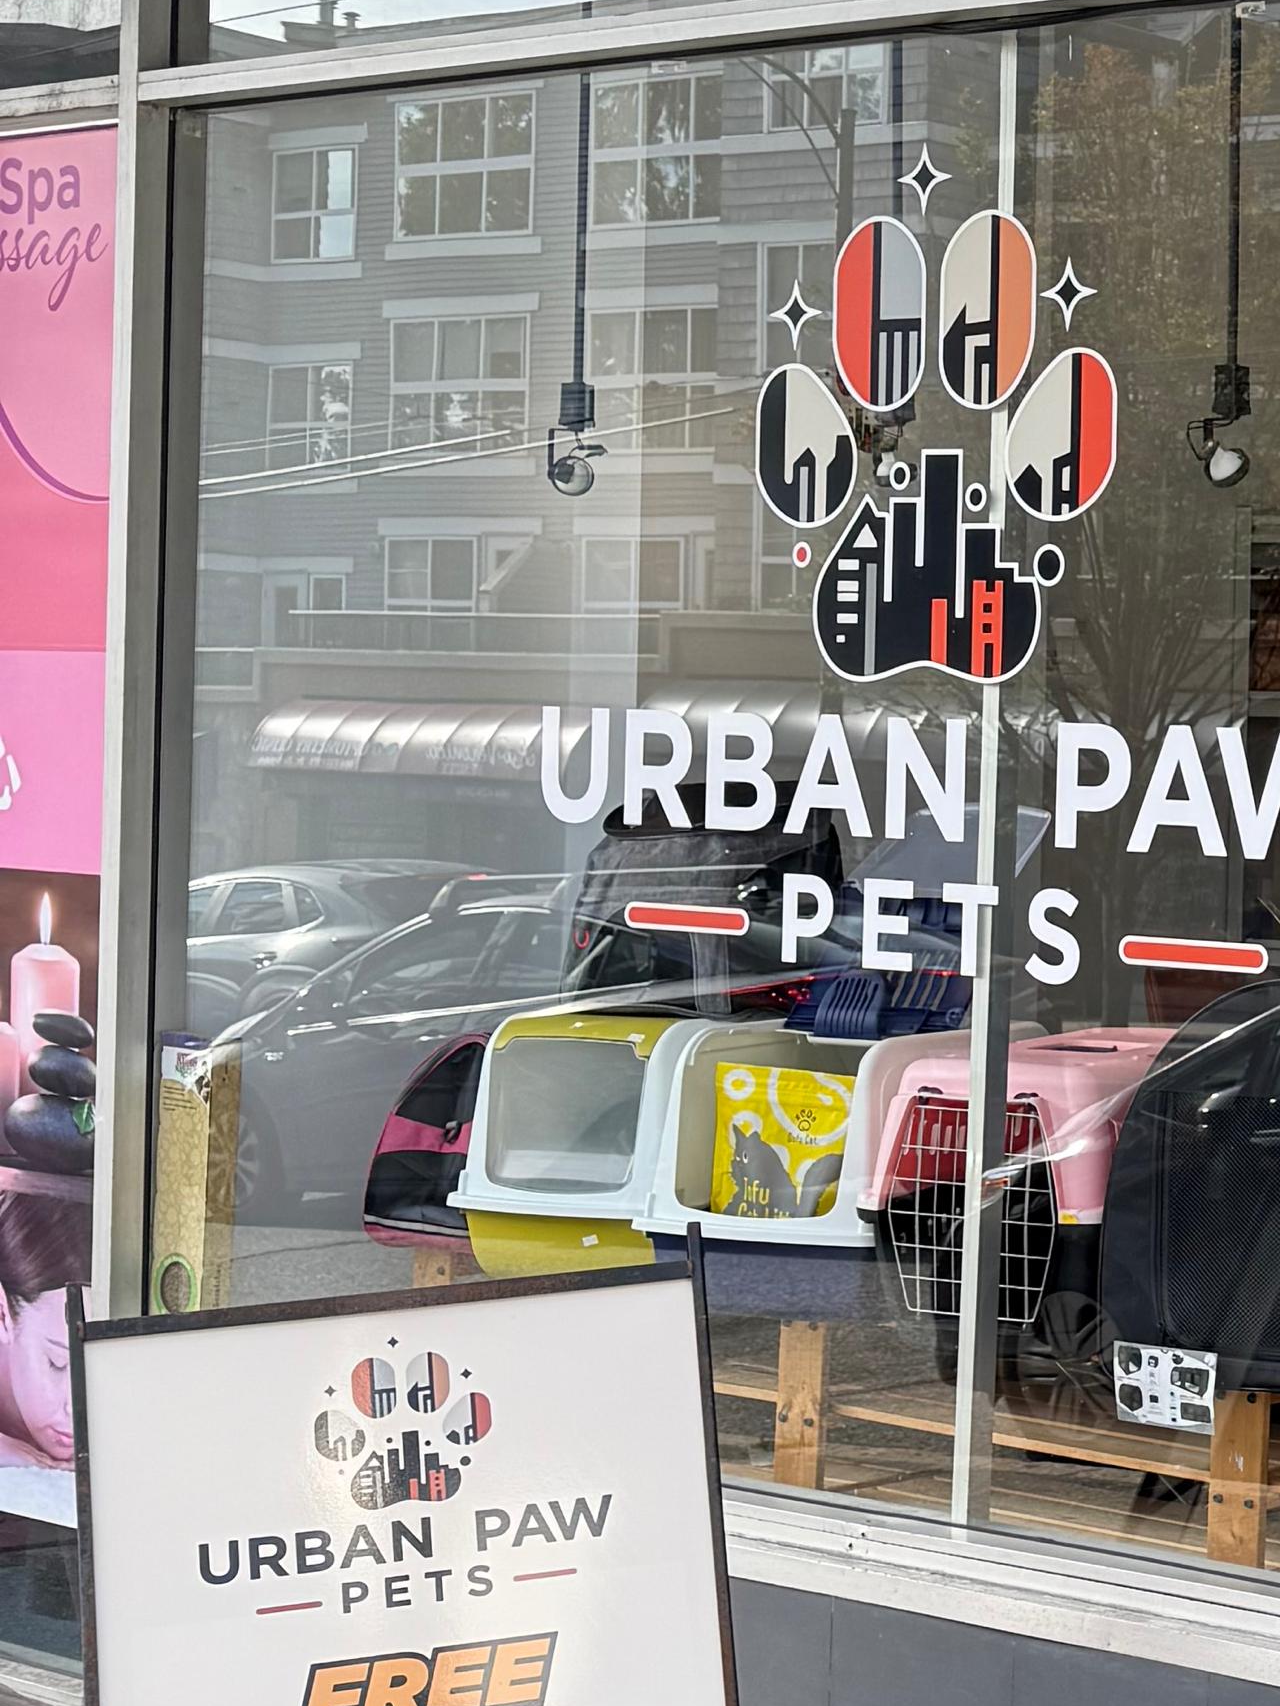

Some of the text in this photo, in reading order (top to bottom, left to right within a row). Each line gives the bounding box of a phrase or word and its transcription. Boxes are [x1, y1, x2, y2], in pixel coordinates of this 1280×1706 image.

[0, 157, 81, 225] Spa
[541, 705, 967, 843] URBAN
[781, 873, 1081, 986] PETS
[198, 1494, 613, 1586] URBAN PAW
[341, 1565, 495, 1614] PETS
